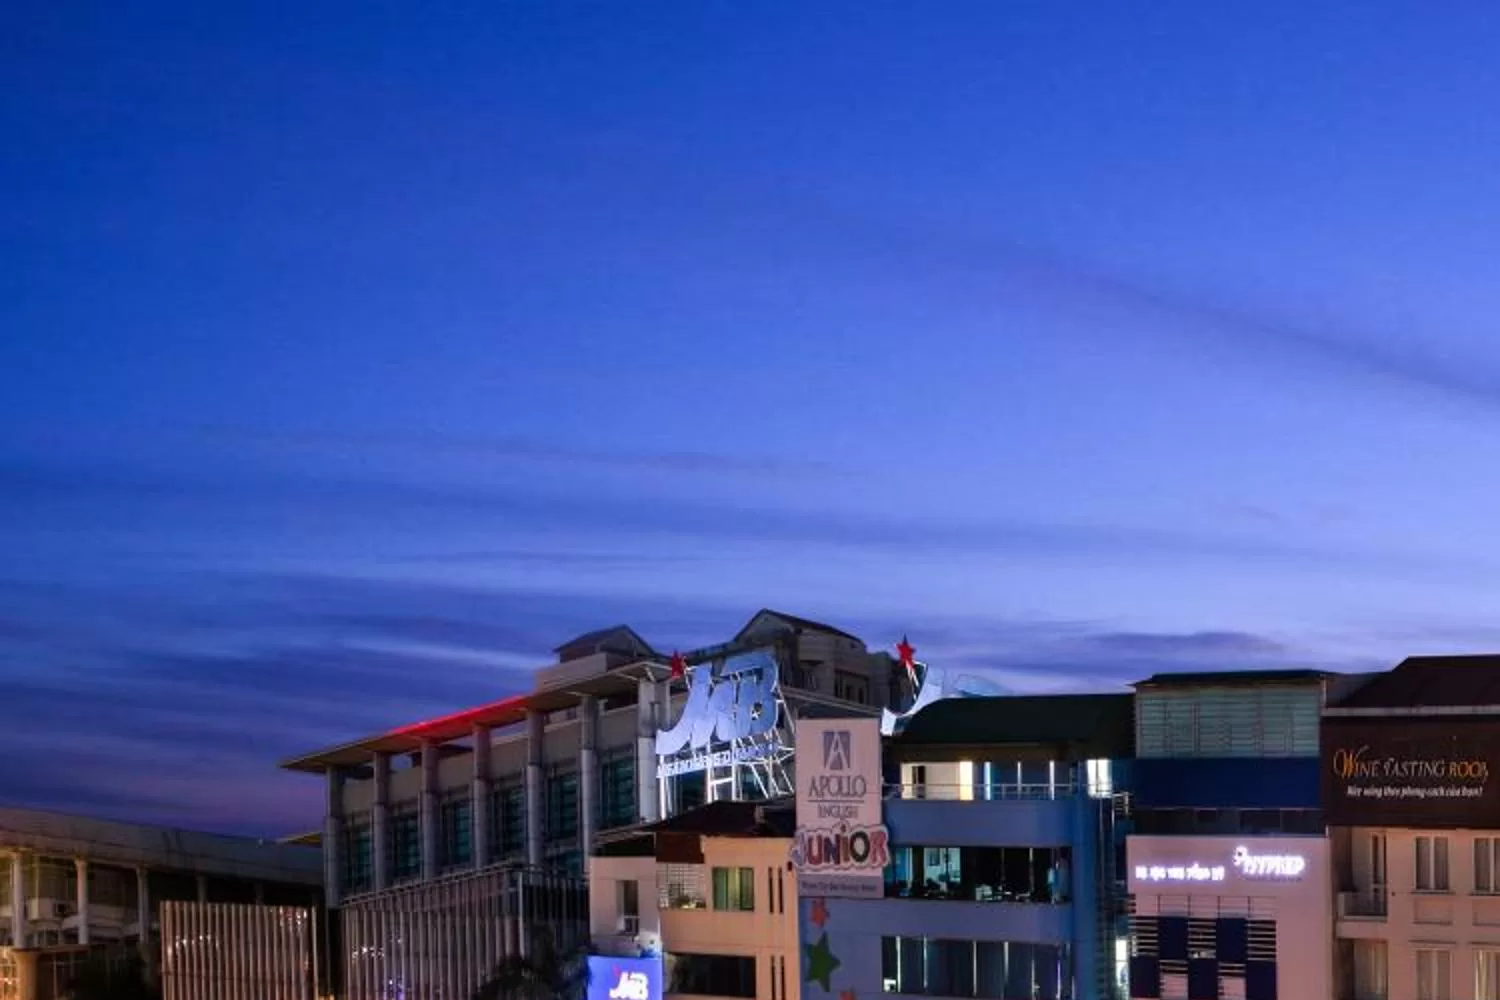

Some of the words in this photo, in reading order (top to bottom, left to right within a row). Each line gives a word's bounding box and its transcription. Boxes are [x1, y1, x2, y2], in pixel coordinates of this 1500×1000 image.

[1333, 745, 1380, 778] WINE
[1384, 757, 1445, 778] TASTING
[808, 774, 867, 798] APOLLO
[817, 804, 859, 819] ENGLISH
